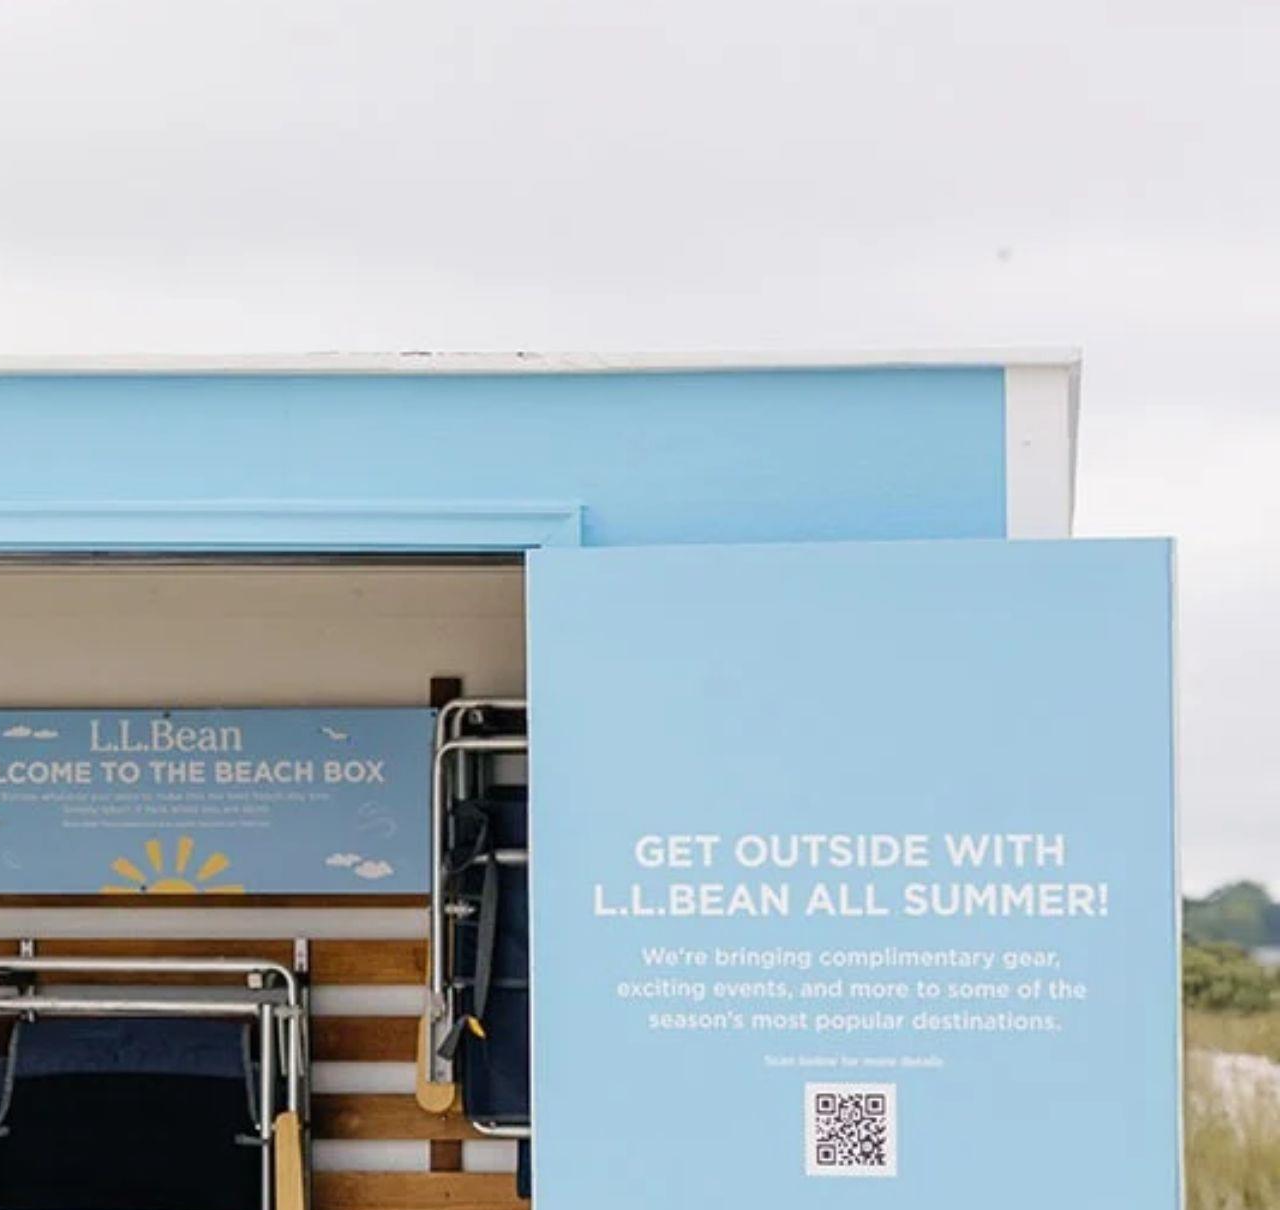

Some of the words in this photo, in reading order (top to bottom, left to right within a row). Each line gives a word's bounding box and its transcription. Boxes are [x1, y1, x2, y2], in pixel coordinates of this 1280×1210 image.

[90, 718, 242, 752] L.L.Bean
[100, 762, 140, 784] TO
[149, 760, 205, 784] THE
[215, 761, 313, 784] BEACH
[324, 761, 384, 783] BOX
[635, 835, 721, 867] GET
[735, 835, 928, 867] OUTSIDE
[944, 834, 1064, 866] WITH
[595, 884, 788, 915] L.L.BEAN
[806, 883, 889, 915] ALL
[904, 883, 1107, 916] SUMMER!
[642, 947, 707, 966] We're
[715, 947, 812, 969] bringing
[819, 947, 995, 969] complimentary
[1003, 952, 1060, 969] gear,
[618, 979, 705, 1001] exciting
[713, 980, 793, 999] events,
[800, 979, 842, 997] and
[850, 983, 909, 998] more
[917, 981, 940, 998] to
[948, 983, 1009, 998] some
[1017, 979, 1041, 998] of
[1049, 979, 1086, 999] the
[649, 1011, 743, 1029] season's
[752, 1012, 807, 1029] most
[815, 1011, 904, 1033] popular
[912, 1011, 1061, 1030] destinations.
